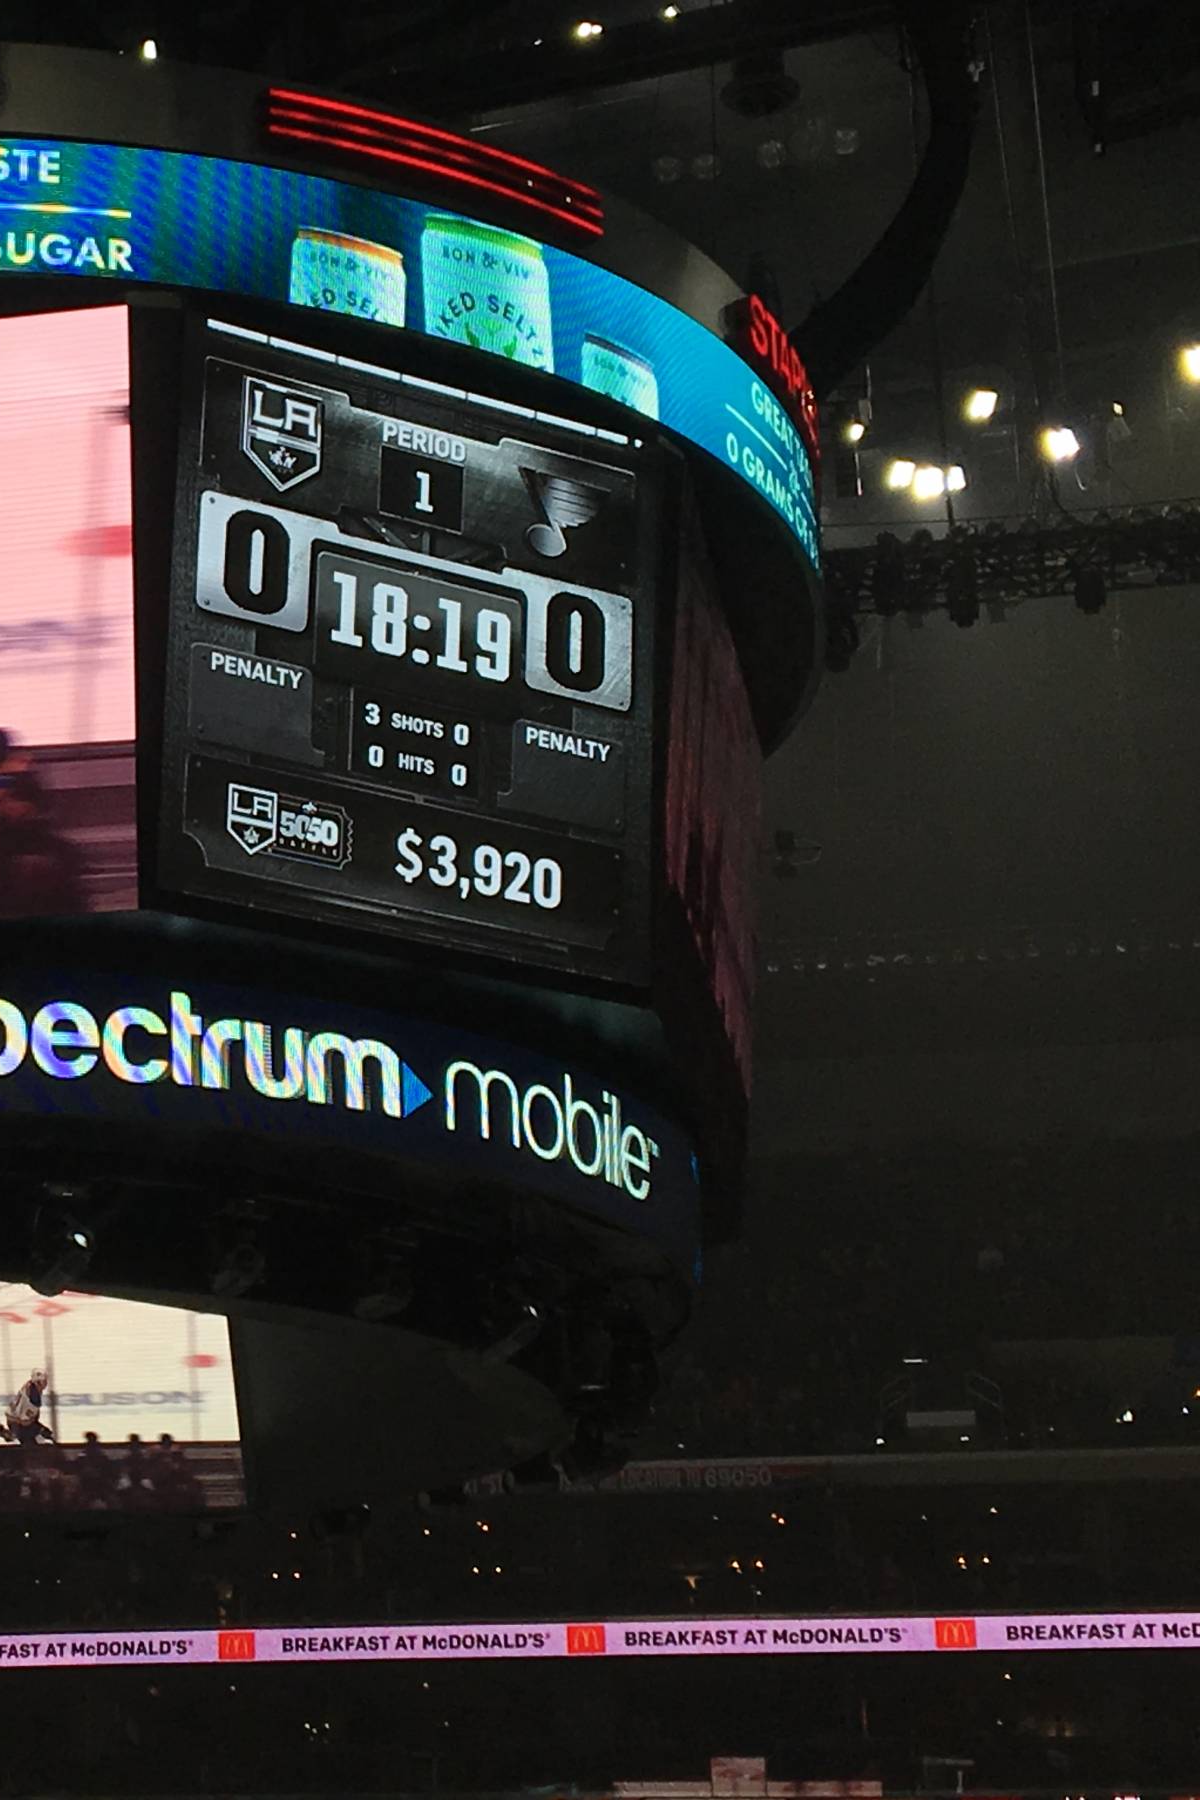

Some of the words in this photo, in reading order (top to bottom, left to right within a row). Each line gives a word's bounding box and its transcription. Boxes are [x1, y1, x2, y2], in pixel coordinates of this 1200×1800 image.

[251, 389, 318, 438] LA
[751, 380, 794, 456] GREAT
[381, 420, 467, 463] PERIOD
[415, 470, 434, 513] 1
[726, 431, 740, 464] 0
[742, 446, 795, 523] GRAMS
[222, 509, 291, 616] 0
[330, 570, 512, 683] 18:19
[544, 590, 607, 694] 0
[210, 651, 304, 690] PENALTY
[364, 703, 381, 727] 3
[391, 711, 444, 739] SHOTS
[454, 723, 470, 747] 0
[525, 726, 612, 763] PENALTY
[367, 744, 384, 769] 0
[398, 752, 435, 776] HITS
[450, 763, 467, 788] 0
[232, 791, 273, 819] LA
[394, 827, 563, 909] $3,920
[45, 1642, 68, 1659] AT
[281, 1635, 391, 1654] BREAKFAST
[395, 1634, 419, 1651] AT
[623, 1629, 740, 1647] BREAKFAST
[743, 1629, 769, 1646] AT
[1005, 1624, 1126, 1641] BREAKFAST
[1132, 1623, 1157, 1640] AT
